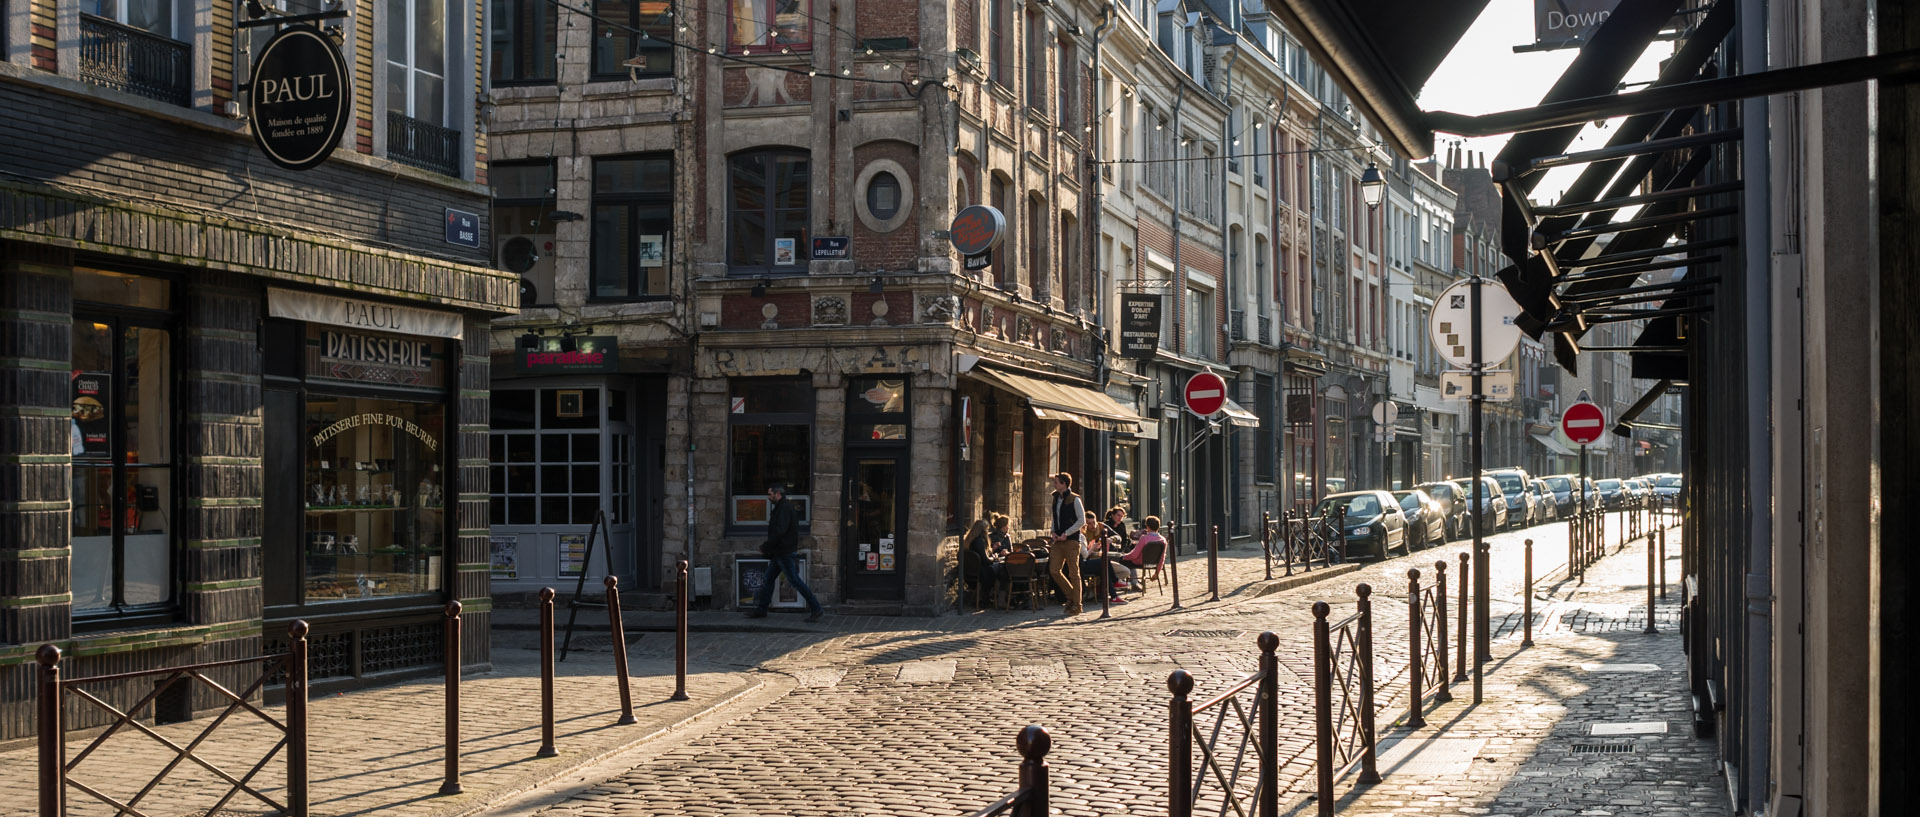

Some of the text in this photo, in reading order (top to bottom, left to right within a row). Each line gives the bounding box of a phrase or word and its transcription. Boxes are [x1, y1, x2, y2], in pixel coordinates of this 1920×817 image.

[261, 73, 334, 105] PAUL
[268, 113, 327, 128] Maison de qualité
[271, 127, 295, 138] fondée
[307, 125, 324, 135] 1889
[462, 217, 470, 228] Rue
[459, 230, 473, 241] BASSE
[967, 255, 988, 269] BAVIK
[344, 301, 401, 330] PAUL
[327, 331, 427, 368] PATISSERIE
[527, 349, 604, 368] parallèle
[313, 412, 438, 452] PATISSERIE FINE PUR BEURRE
